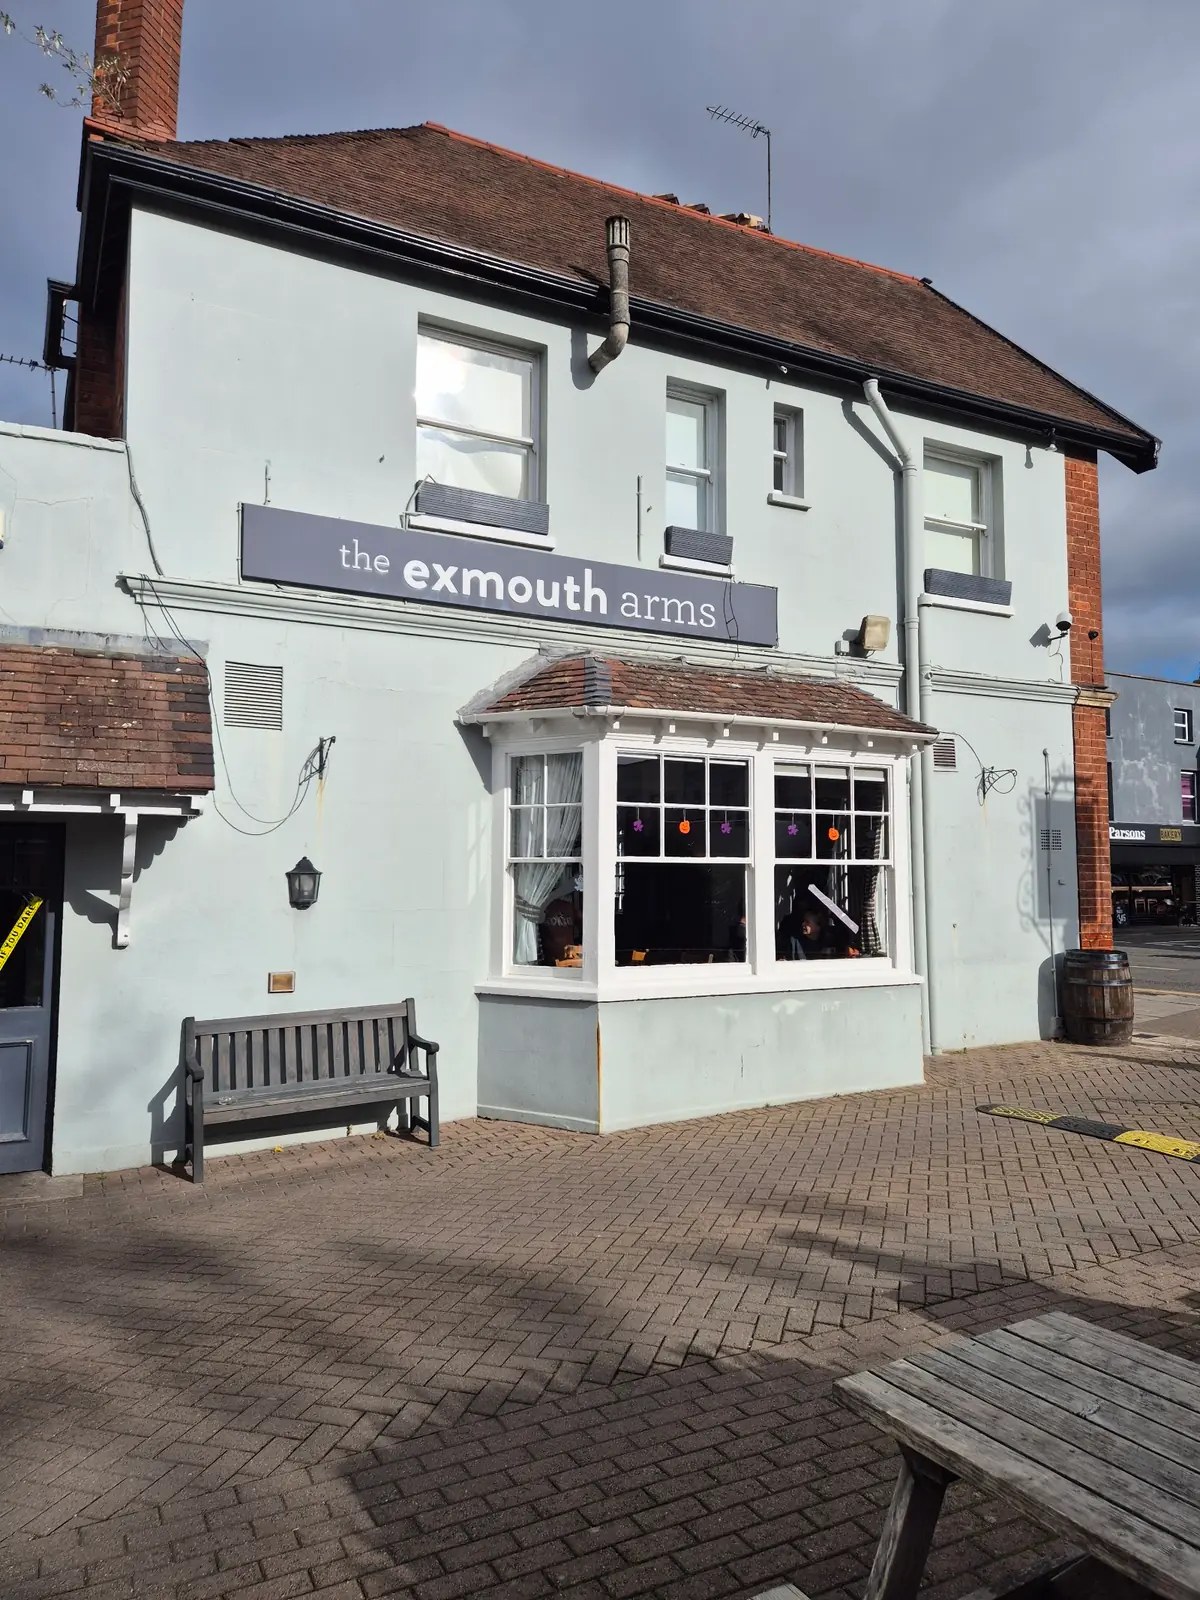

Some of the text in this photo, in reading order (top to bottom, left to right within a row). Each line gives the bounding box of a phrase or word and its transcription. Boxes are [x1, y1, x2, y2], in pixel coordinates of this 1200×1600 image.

[339, 539, 716, 628] the exmouth arms
[1109, 826, 1146, 840] Parsons
[1160, 828, 1181, 840] BAKERY
[5, 930, 18, 948] YOU
